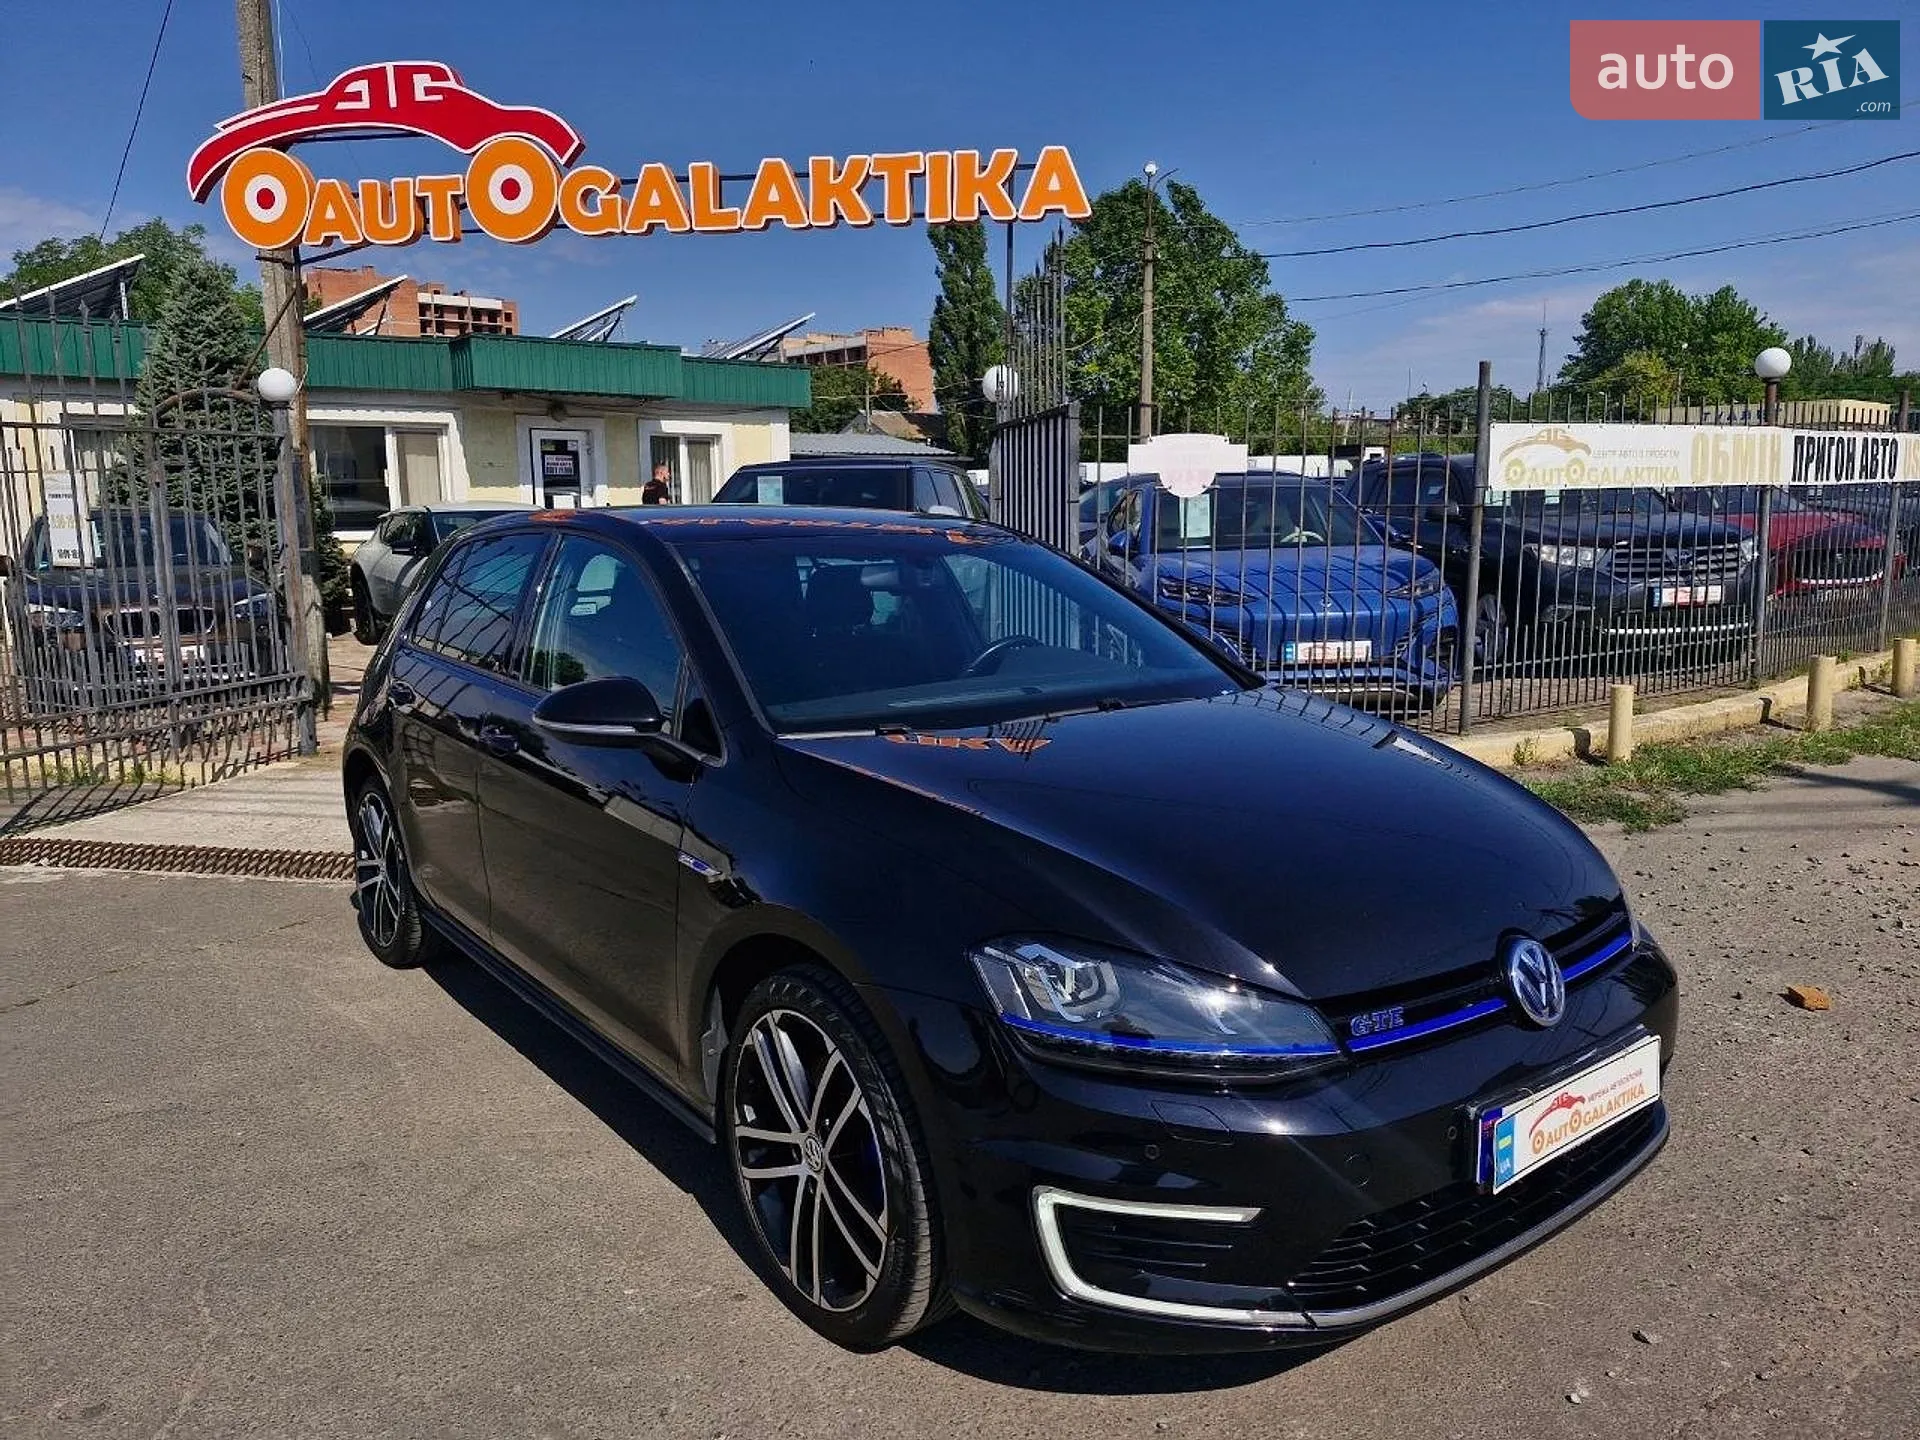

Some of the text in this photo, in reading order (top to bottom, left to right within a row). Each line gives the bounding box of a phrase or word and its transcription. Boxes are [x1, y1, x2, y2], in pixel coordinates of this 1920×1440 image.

[1690, 432, 1783, 483] ОБМІН
[1791, 434, 1857, 482] ПРИГОН
[1858, 437, 1898, 480] АВТО
[1350, 1006, 1404, 1037] GTE
